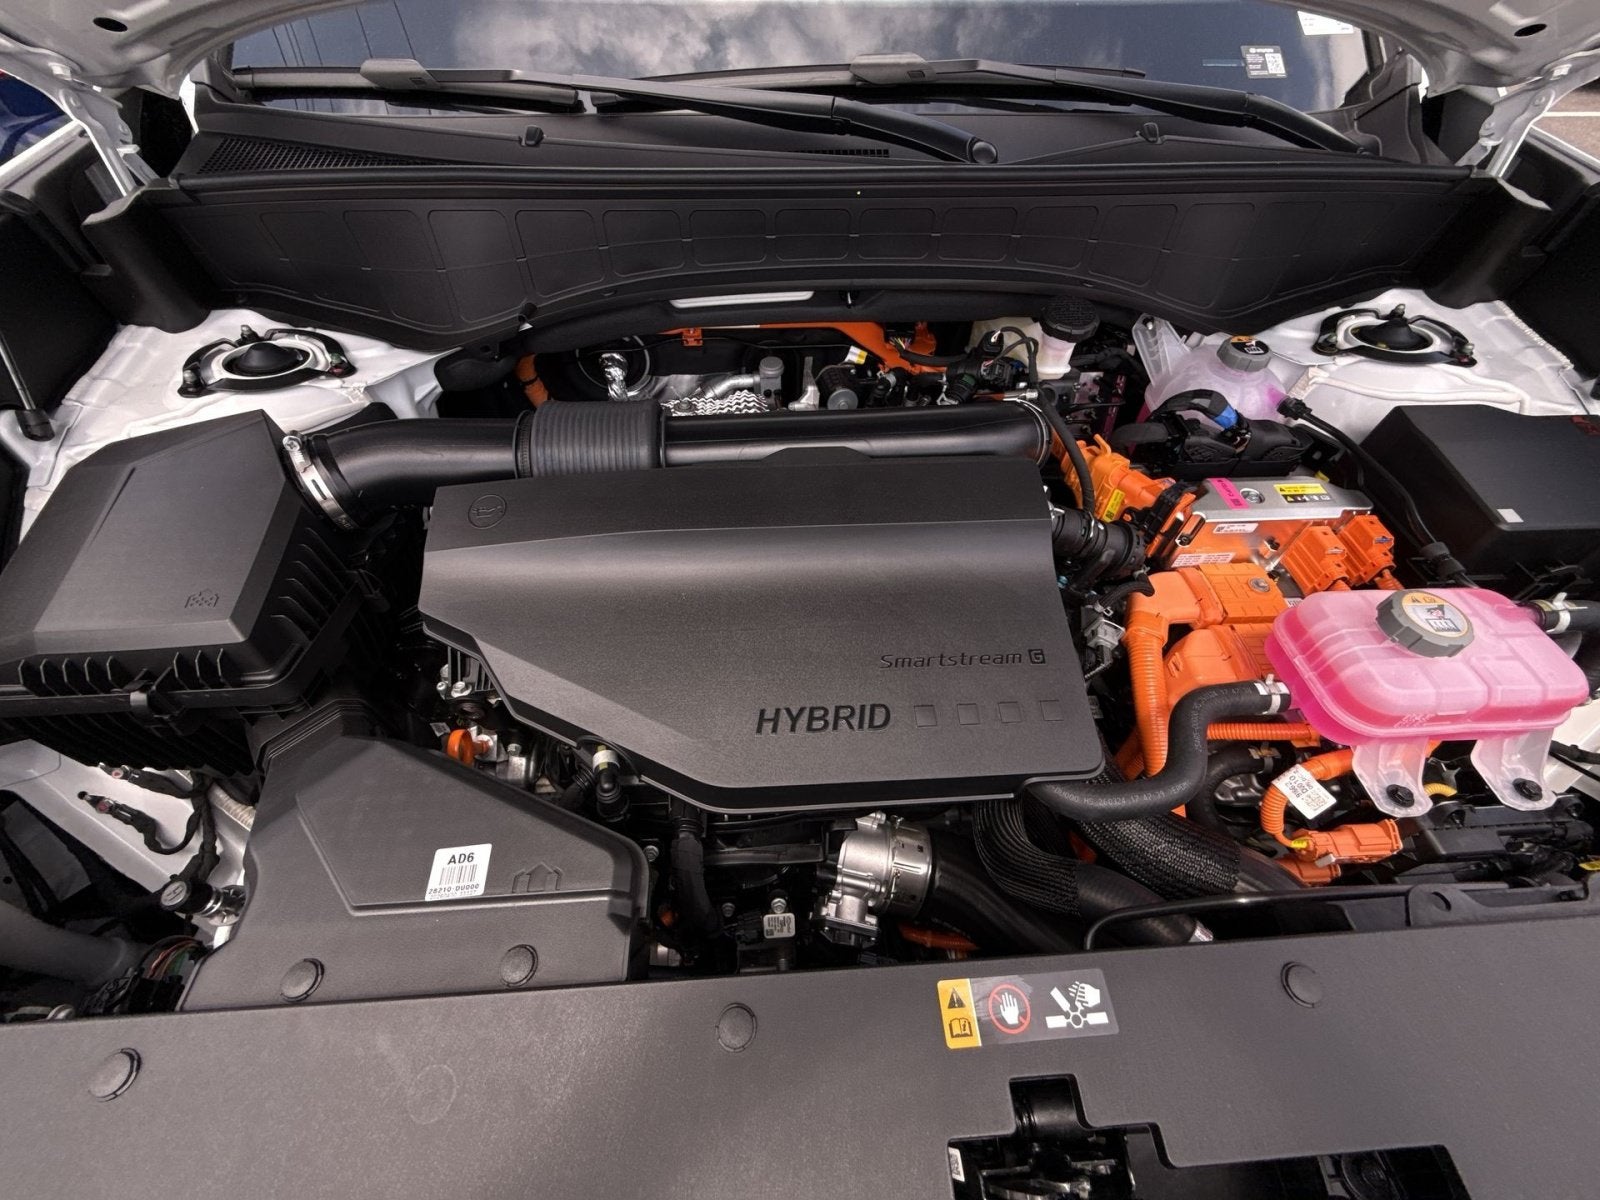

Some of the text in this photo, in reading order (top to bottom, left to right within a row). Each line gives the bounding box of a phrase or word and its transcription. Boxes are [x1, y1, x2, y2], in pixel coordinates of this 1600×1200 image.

[880, 652, 1022, 669] Smartstream
[755, 703, 891, 735] HYBRID
[447, 852, 475, 865] AD6
